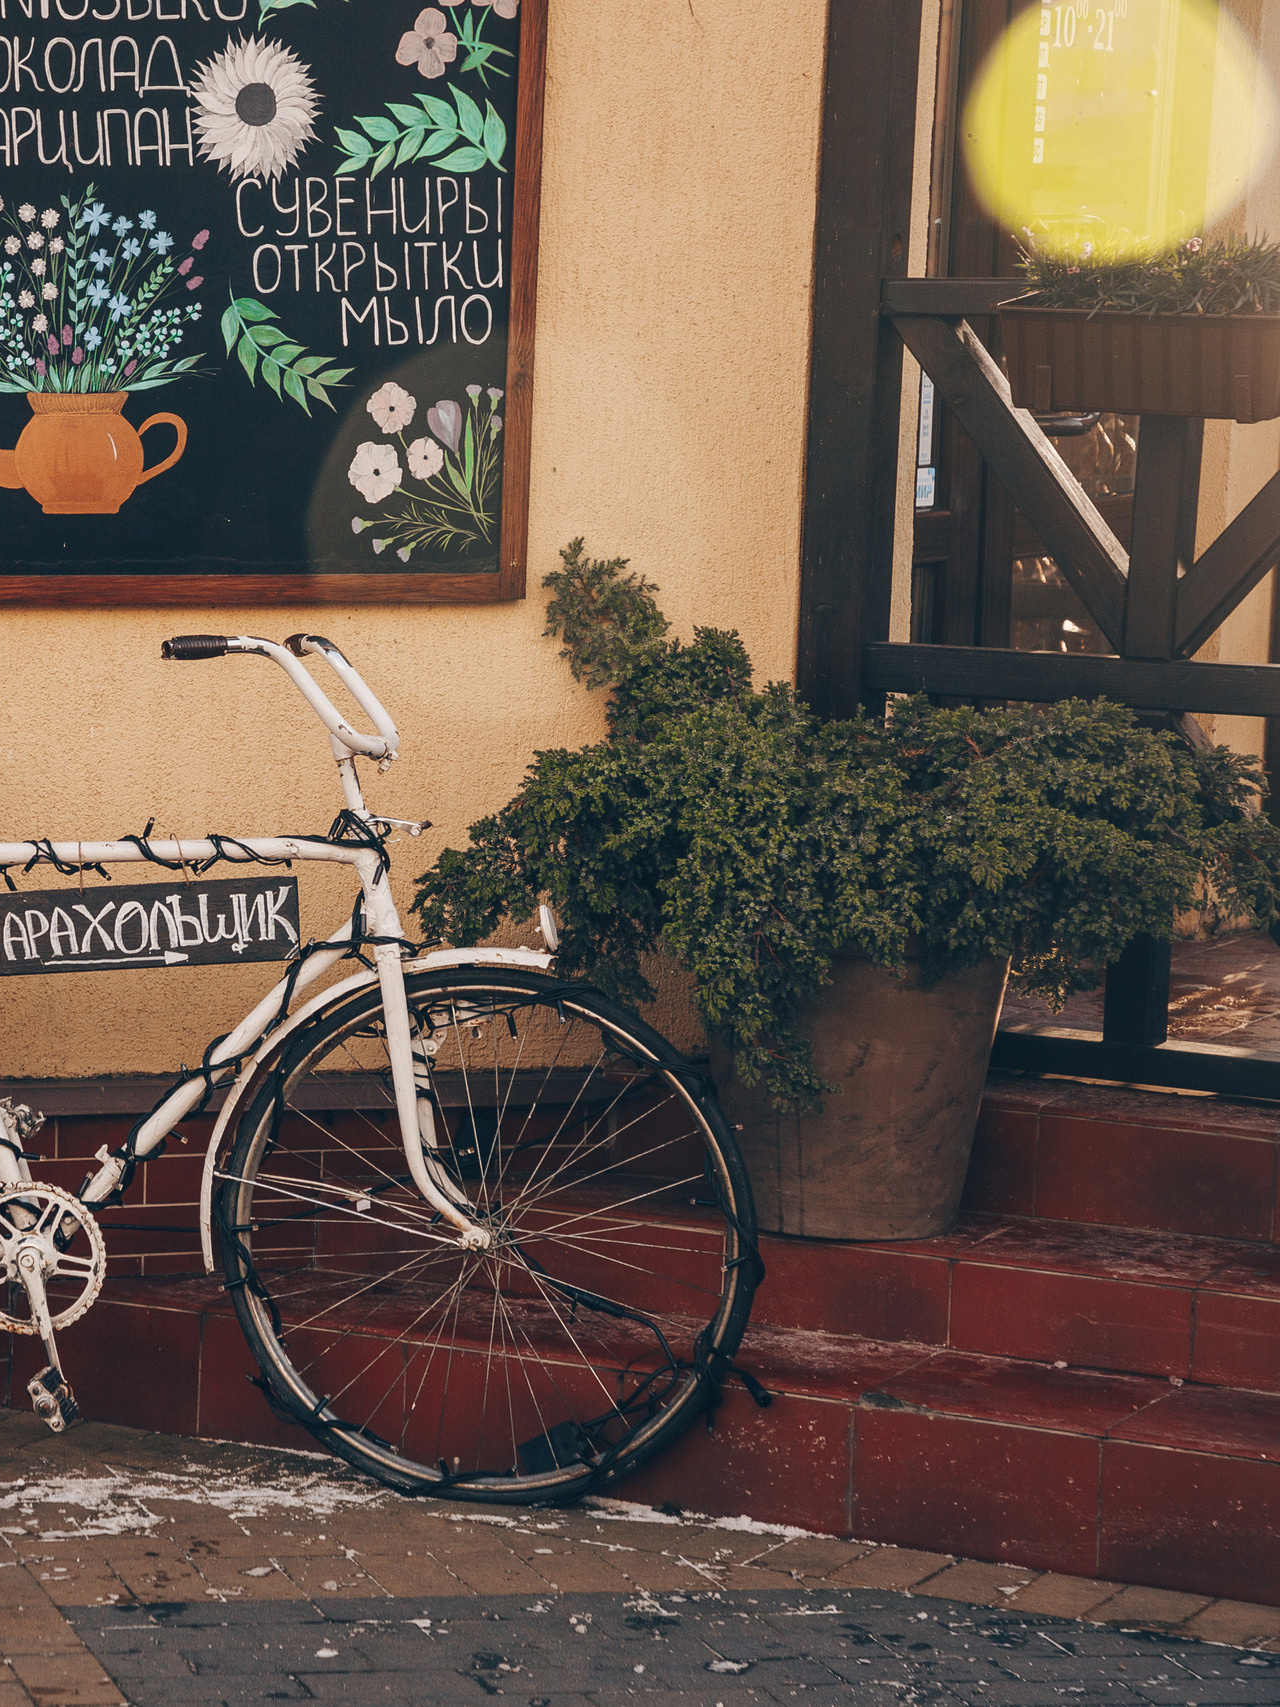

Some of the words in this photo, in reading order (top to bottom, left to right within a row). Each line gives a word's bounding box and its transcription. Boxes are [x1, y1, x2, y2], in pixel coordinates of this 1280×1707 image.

[235, 176, 502, 237] СУВЕНИРЫ
[252, 240, 503, 294] ОТКРЫТКИ
[340, 294, 494, 346] МЫЛО
